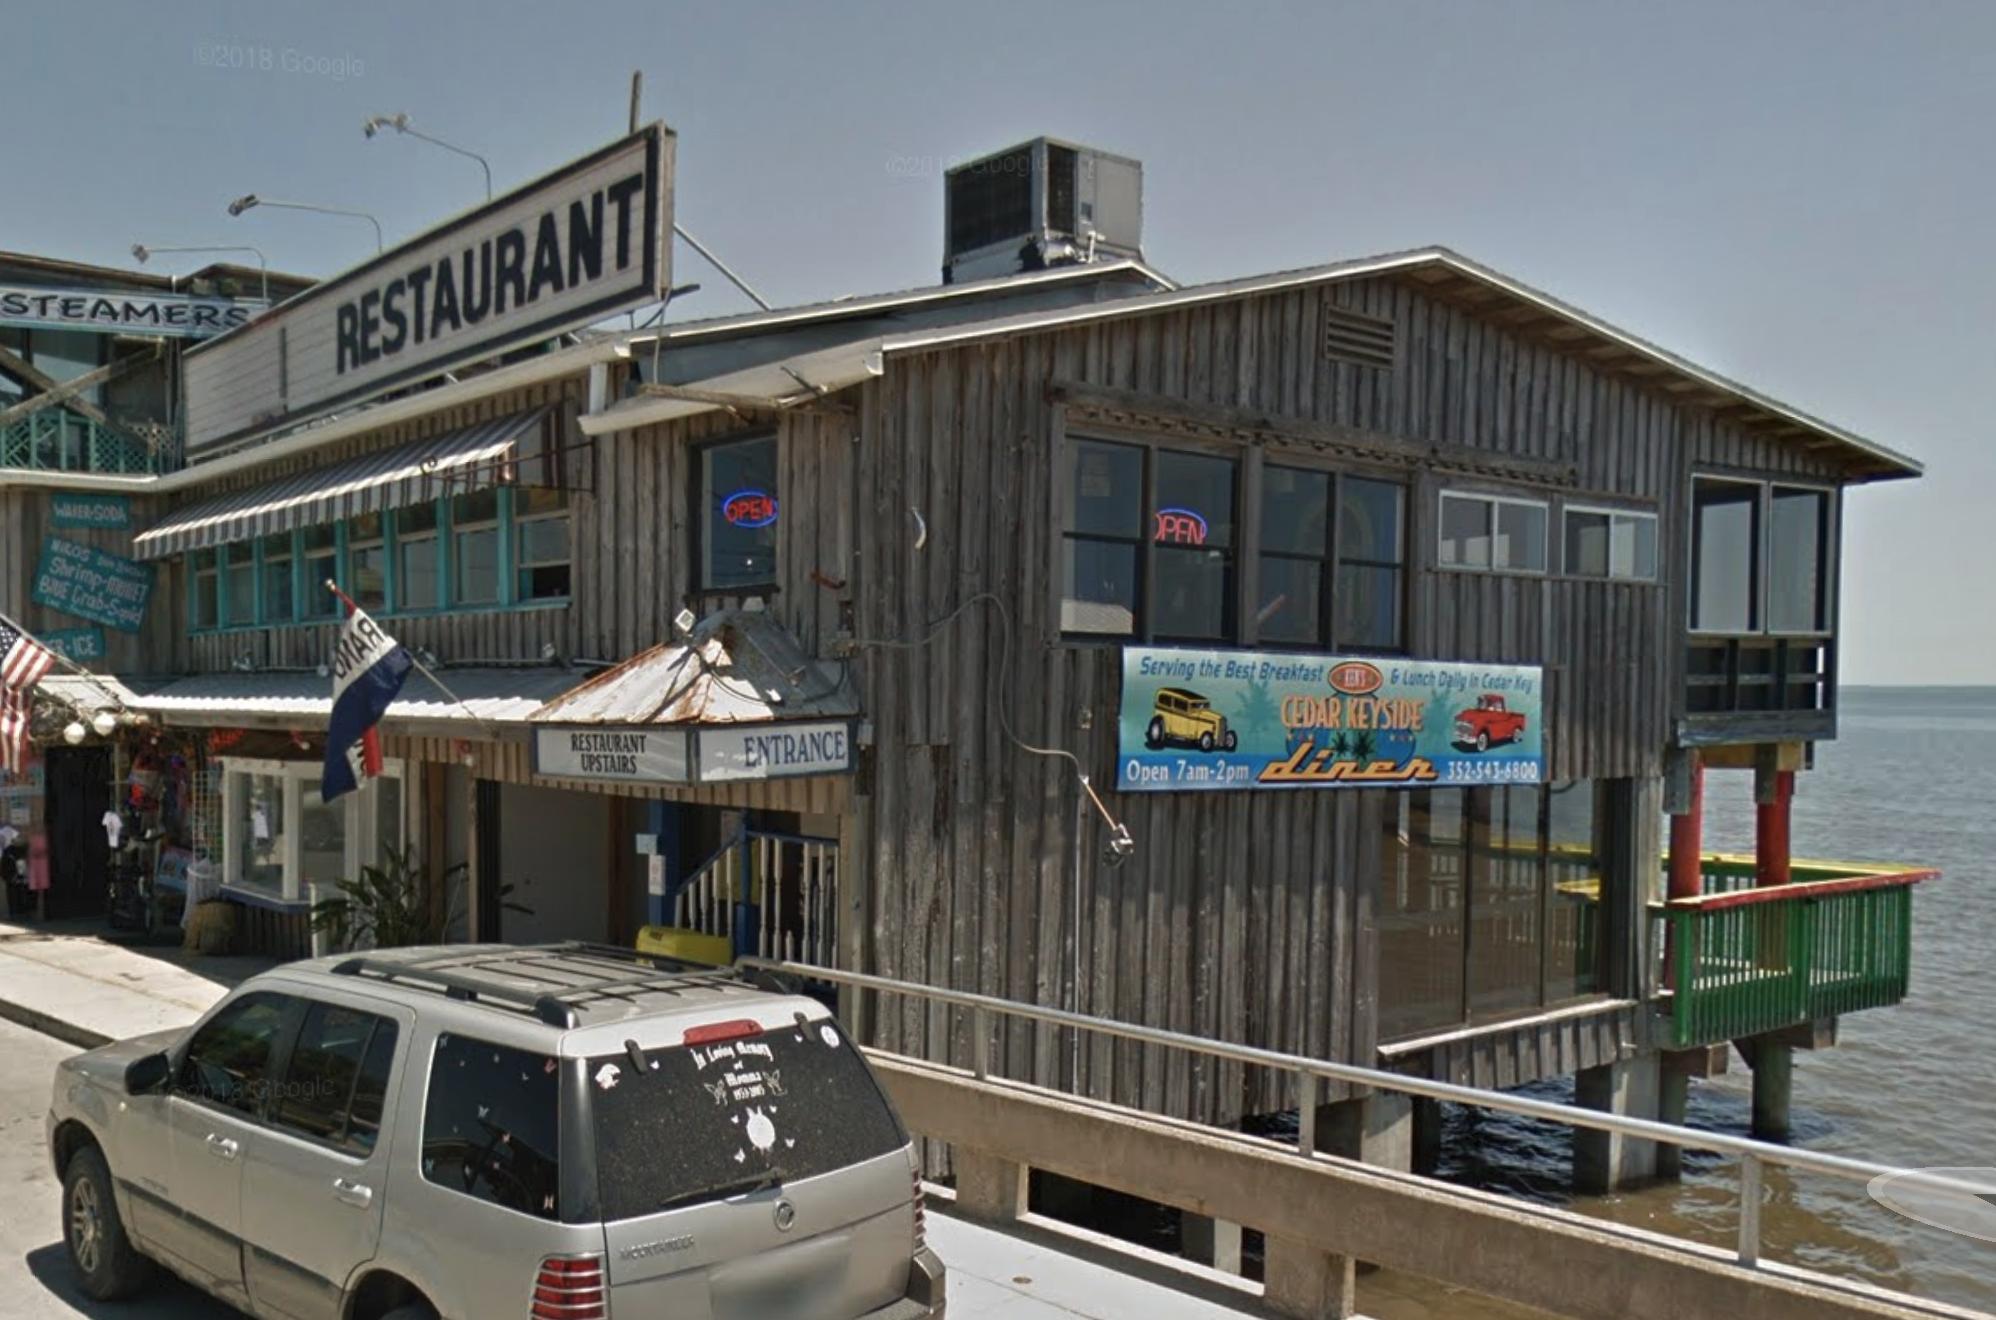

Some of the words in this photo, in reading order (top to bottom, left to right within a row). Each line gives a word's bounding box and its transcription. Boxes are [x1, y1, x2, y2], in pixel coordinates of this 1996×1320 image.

[337, 172, 643, 375] RESTAURANT
[1, 293, 250, 328] STEAMERS
[726, 496, 773, 523] OPEN
[1139, 656, 1195, 681] Serving
[1200, 659, 1222, 678] the
[1225, 660, 1256, 681] Best
[1259, 661, 1324, 682] Breakfast
[1391, 668, 1400, 685] &
[1403, 669, 1436, 687] Lunch
[1439, 670, 1467, 693] Daily
[1482, 673, 1513, 690] Cedar
[1516, 675, 1534, 694] Key
[1281, 695, 1341, 728] CEDAR
[1346, 698, 1425, 731] KEYSIDE
[570, 733, 648, 754] RESTAURANT
[743, 730, 847, 768] ENTRANCE
[580, 754, 638, 774] UPSTAIRS
[1127, 759, 1170, 784] Open
[1177, 759, 1250, 784] 7am-2pm
[1257, 740, 1440, 781] diner
[1447, 761, 1539, 780] 352-543-6800
